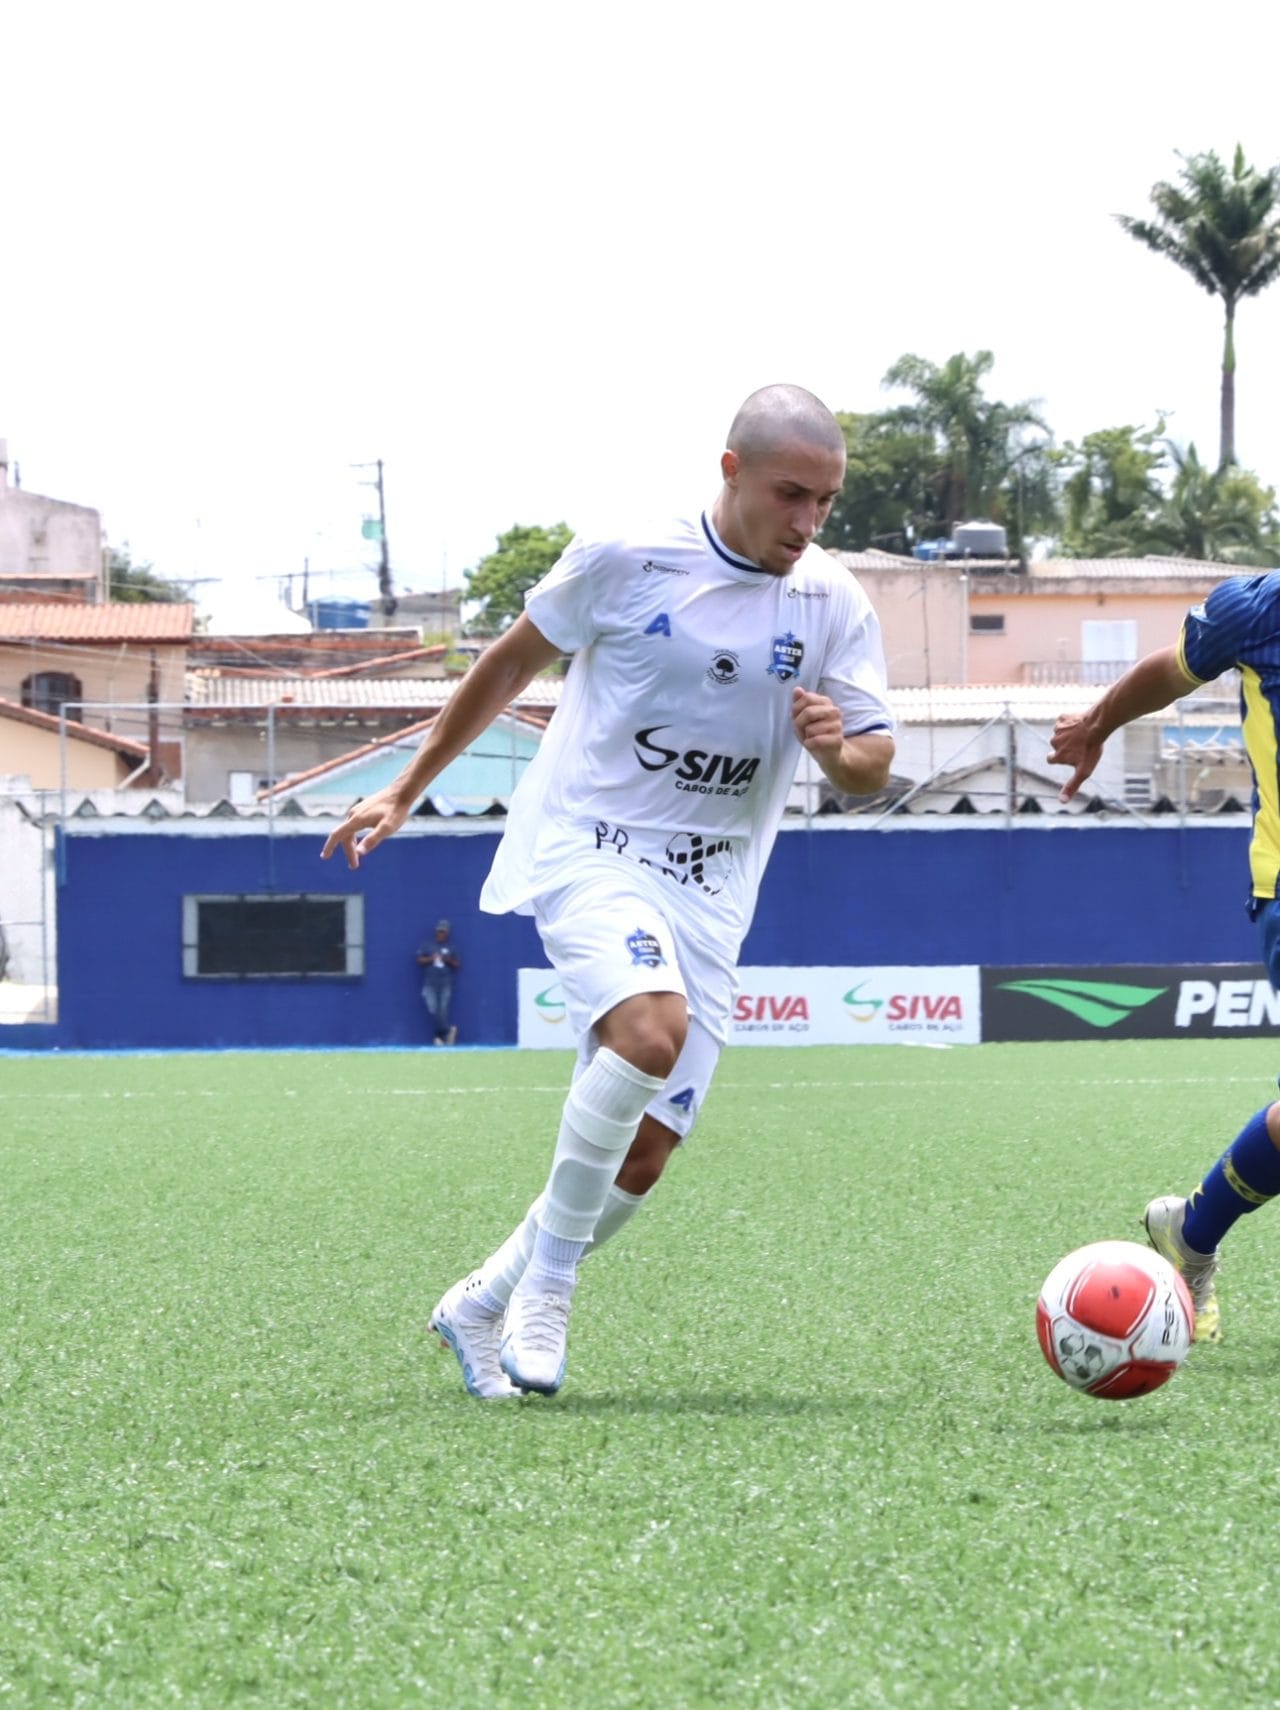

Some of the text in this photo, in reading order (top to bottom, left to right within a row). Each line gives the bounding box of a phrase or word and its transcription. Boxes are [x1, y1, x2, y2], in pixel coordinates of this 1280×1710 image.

[675, 750, 760, 786] SIVA
[675, 780, 714, 794] CABOS
[715, 787, 730, 795] DE
[733, 995, 809, 1021] SIVA
[886, 995, 962, 1020] SIVA
